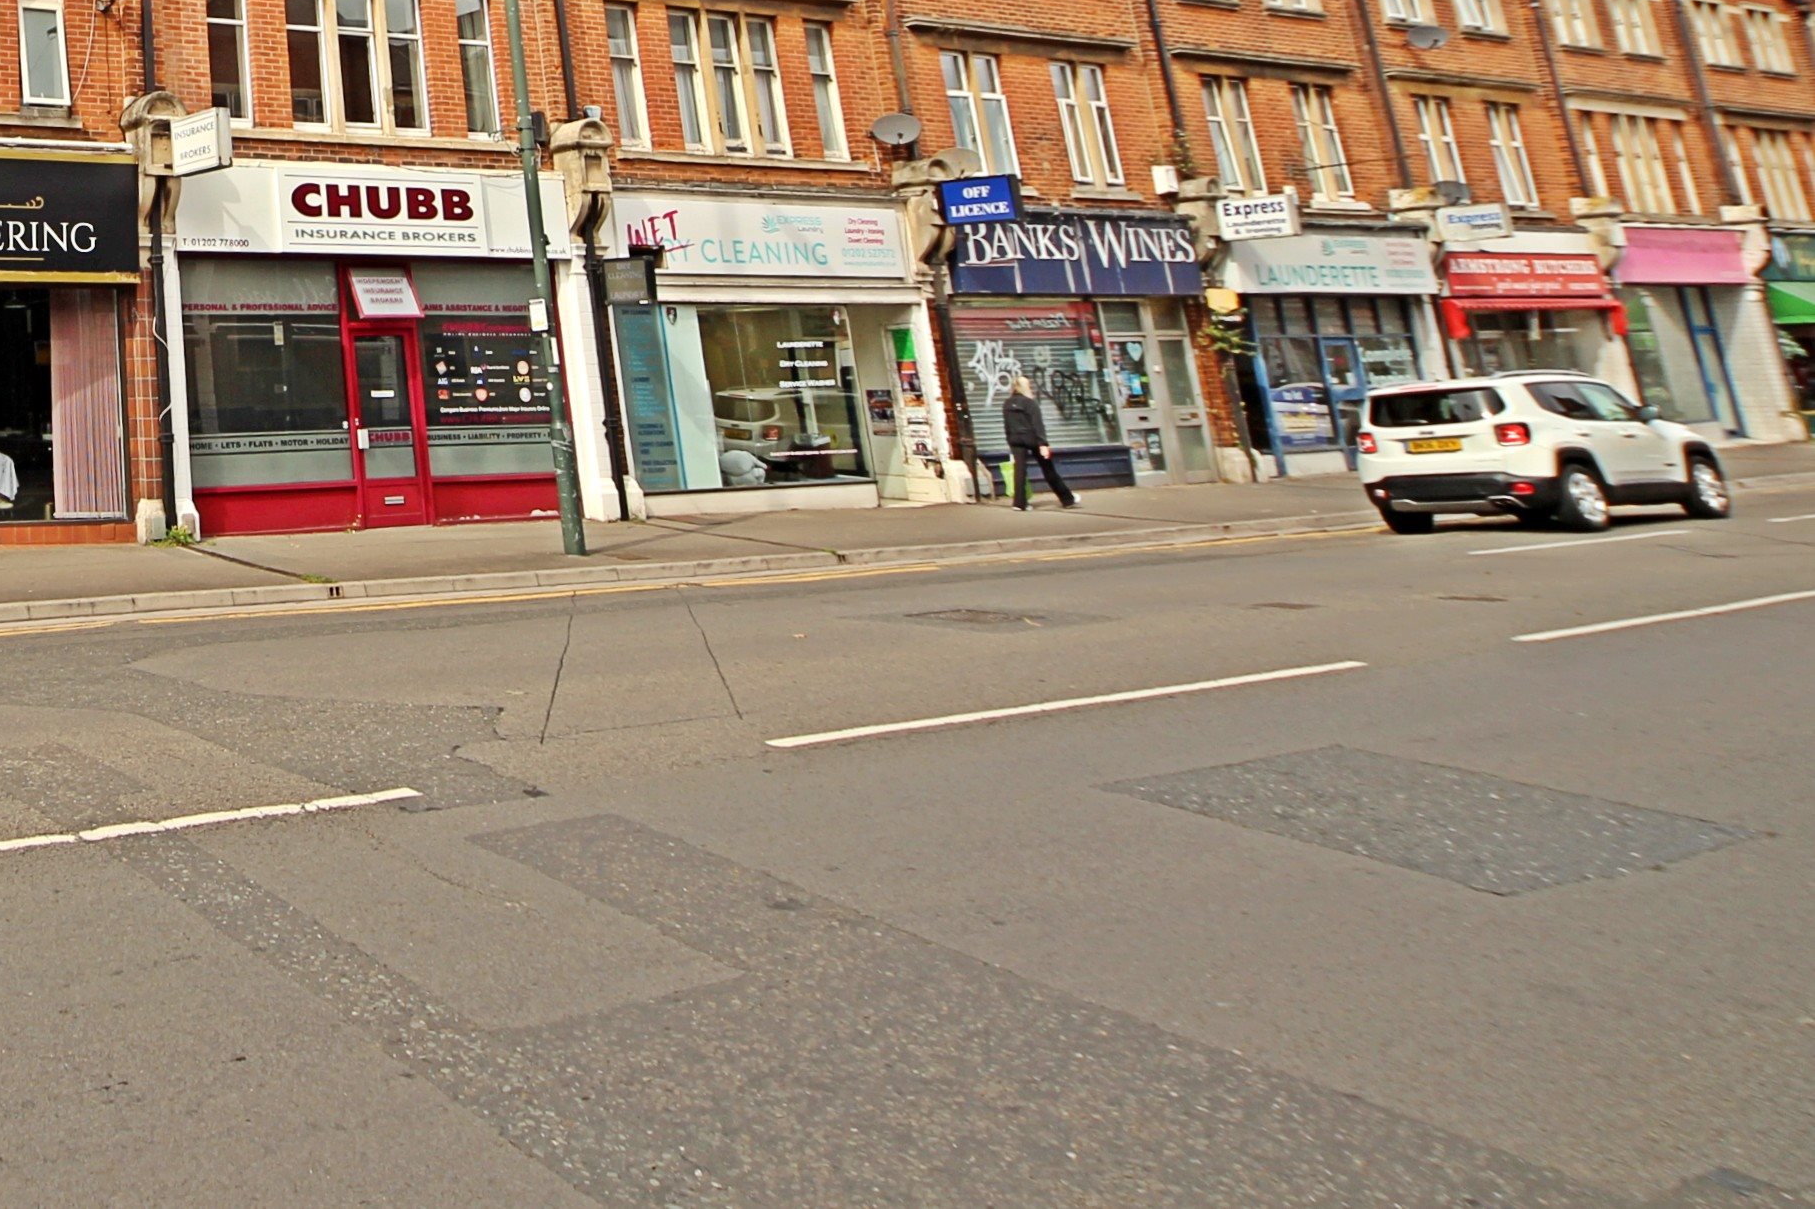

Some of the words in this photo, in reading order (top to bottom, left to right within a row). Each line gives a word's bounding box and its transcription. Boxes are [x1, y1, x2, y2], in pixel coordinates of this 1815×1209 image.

[174, 122, 214, 140] INSURANCE
[180, 145, 211, 159] BROKERS
[962, 185, 990, 199] OFF
[291, 183, 474, 221] CHUBB
[950, 201, 1010, 218] LICENCE
[1223, 201, 1285, 220] Express
[627, 210, 679, 246] WET
[778, 216, 823, 226] EXPRESS
[857, 218, 878, 226] Cleaning
[295, 229, 396, 242] INSURANCE
[402, 232, 477, 243] BROKERS
[191, 238, 217, 248] 01202
[219, 240, 249, 249] 778000
[964, 221, 1080, 265] BANKS
[1086, 220, 1195, 269] WINES
[701, 239, 829, 266] CLEANING
[1255, 264, 1381, 287] LAUNDERETTE
[183, 303, 228, 312] PERSONAL
[239, 303, 304, 312] PROFESSIONAL
[306, 303, 338, 312] ADVICE
[445, 304, 493, 312] ASSISTANCE
[249, 440, 273, 448] FLATS
[281, 439, 308, 447] MOTOR
[316, 437, 349, 445] HOLIDAY
[428, 433, 461, 441] BUSINESS
